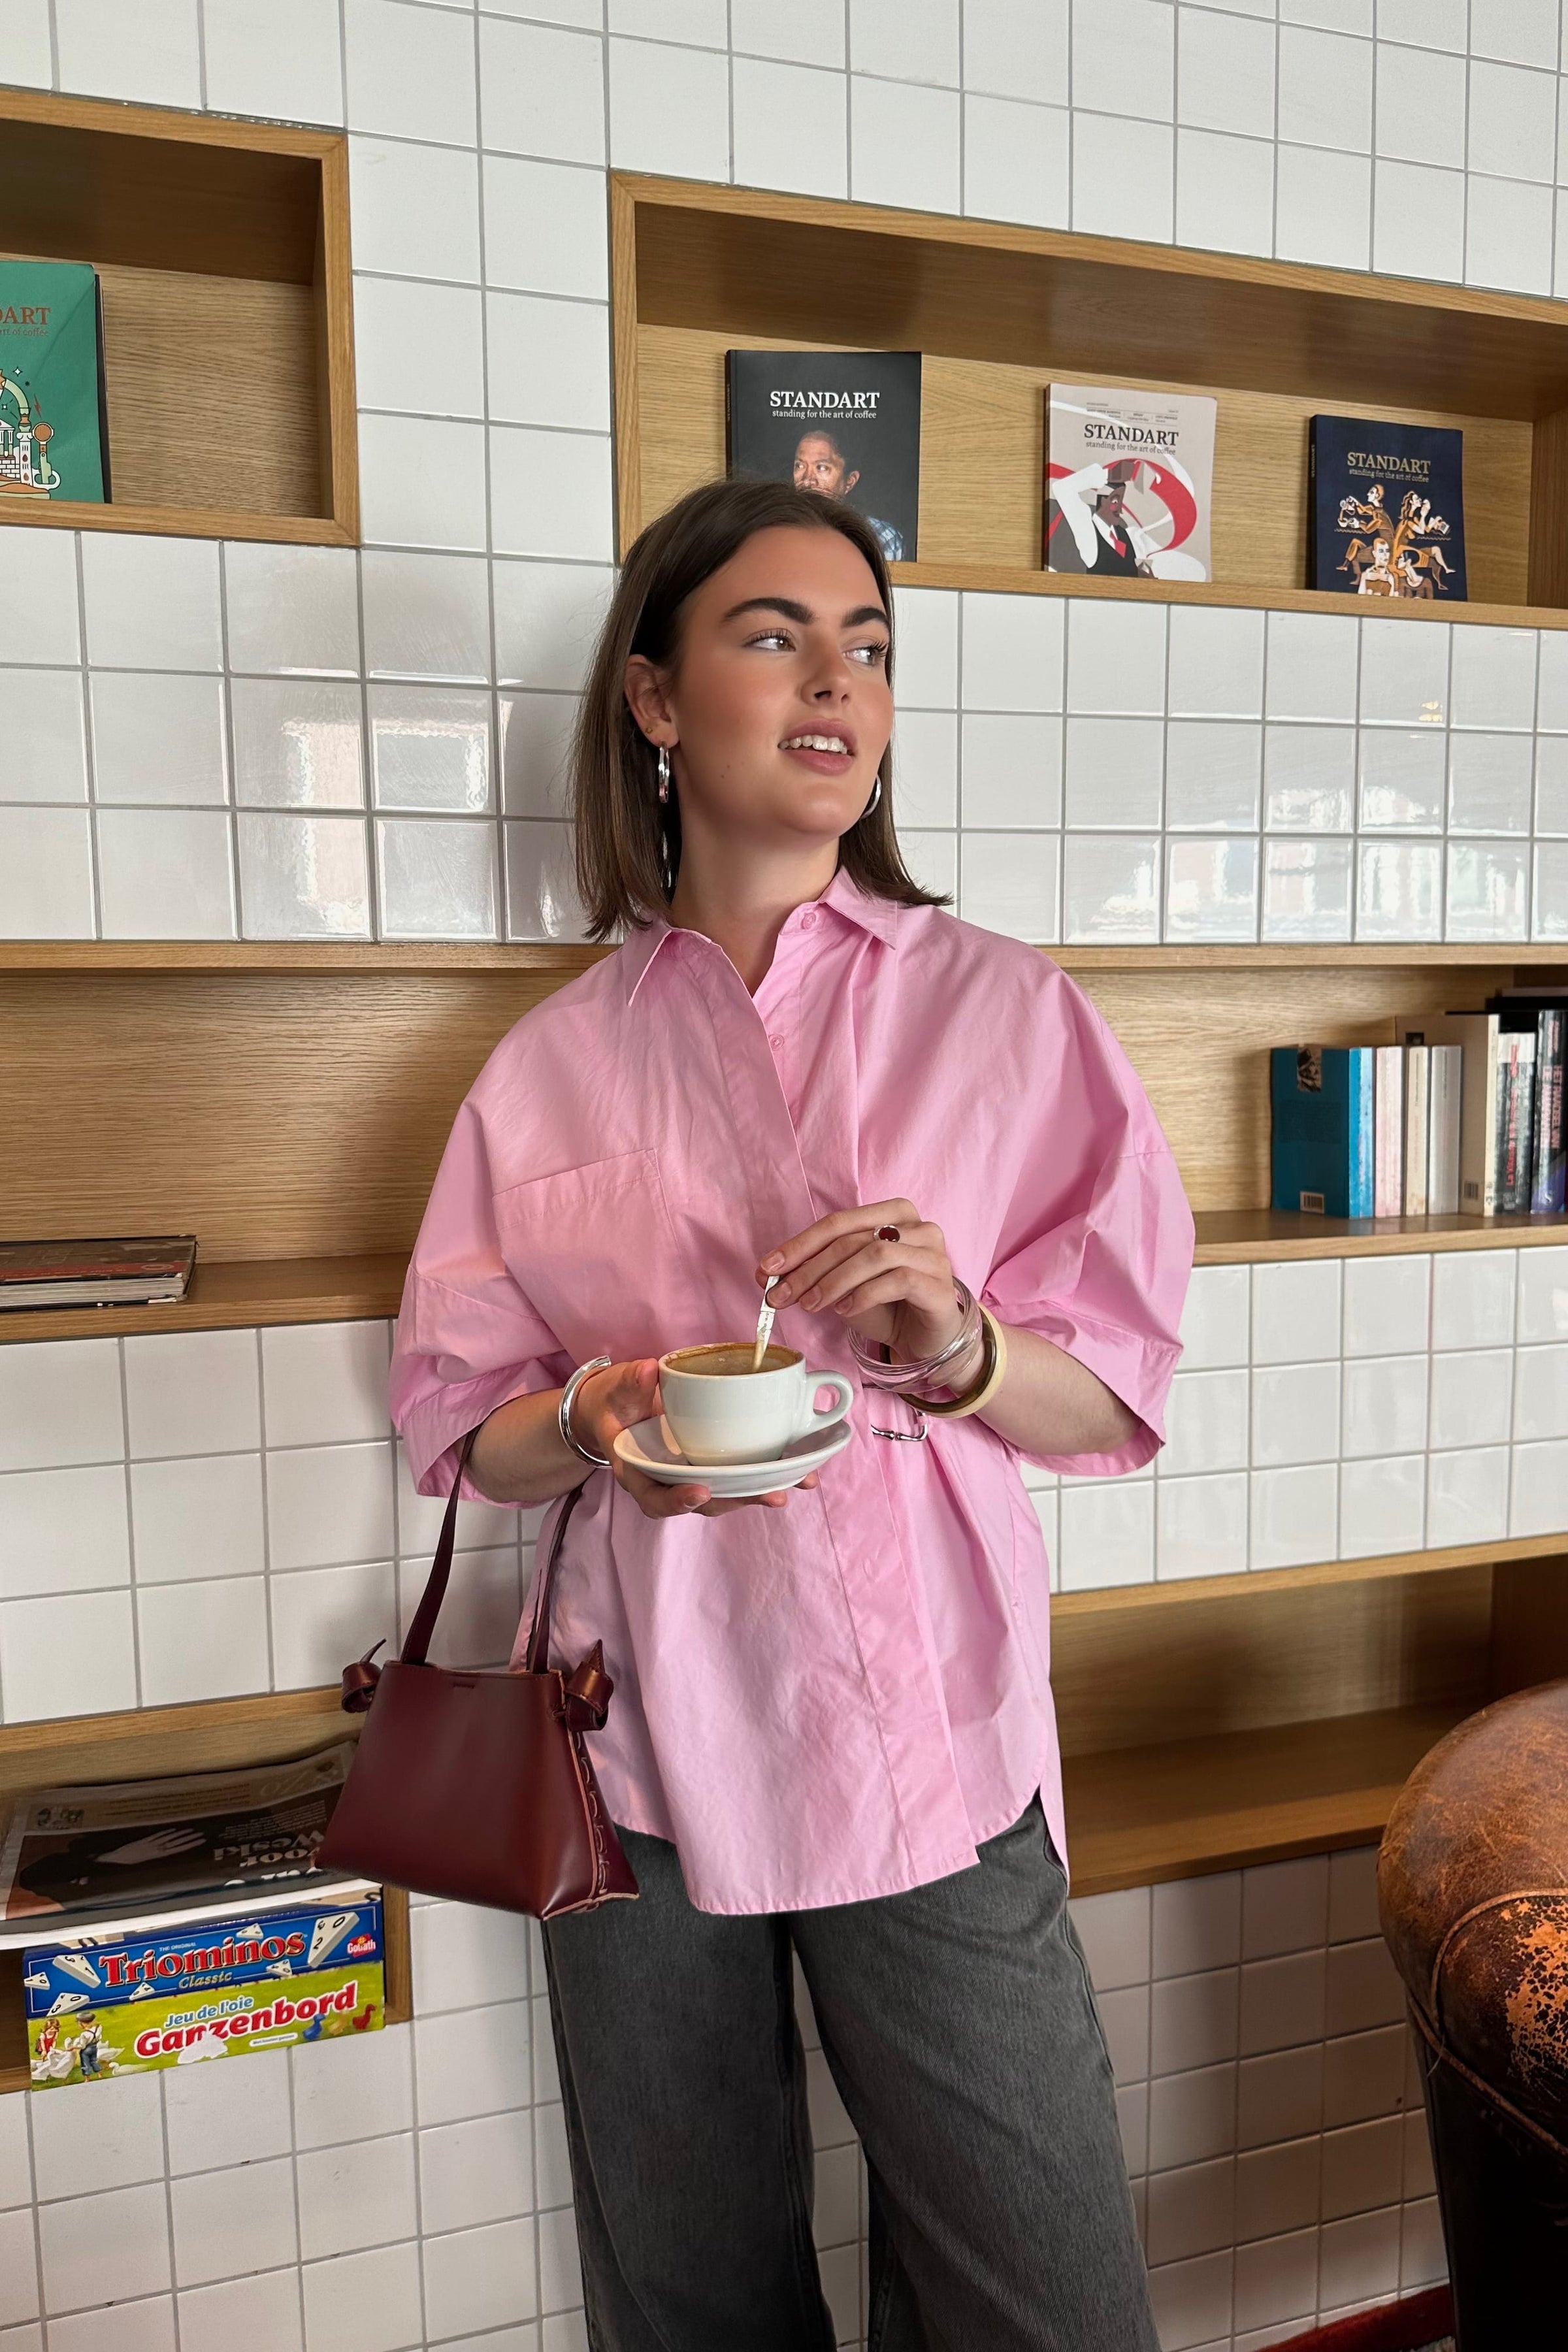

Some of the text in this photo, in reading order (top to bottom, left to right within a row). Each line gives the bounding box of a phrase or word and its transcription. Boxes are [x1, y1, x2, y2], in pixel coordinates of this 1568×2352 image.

[0, 306, 51, 325] ART
[23, 328, 48, 337] coffee
[770, 391, 880, 408] STANDART
[772, 409, 806, 419] standing
[807, 410, 817, 418] for
[845, 410, 853, 419] of
[854, 410, 877, 419] coffee
[1084, 424, 1179, 446] STANDART
[1086, 441, 1115, 451] standing
[1117, 442, 1126, 451] for
[1156, 447, 1176, 455] coffee
[1347, 451, 1431, 474] STANDART
[1349, 468, 1375, 478] standing
[1375, 470, 1384, 478] for
[1385, 471, 1395, 480] the
[1411, 474, 1429, 483] coffee
[171, 1942, 195, 1950] ORIGINAL
[347, 1938, 376, 1954] Goliath
[99, 1932, 306, 1987] Triominos
[178, 1970, 233, 1989] Classic
[136, 1982, 357, 2057] Ganzenbord
[165, 1996, 253, 2028] Jeu de l'oie
